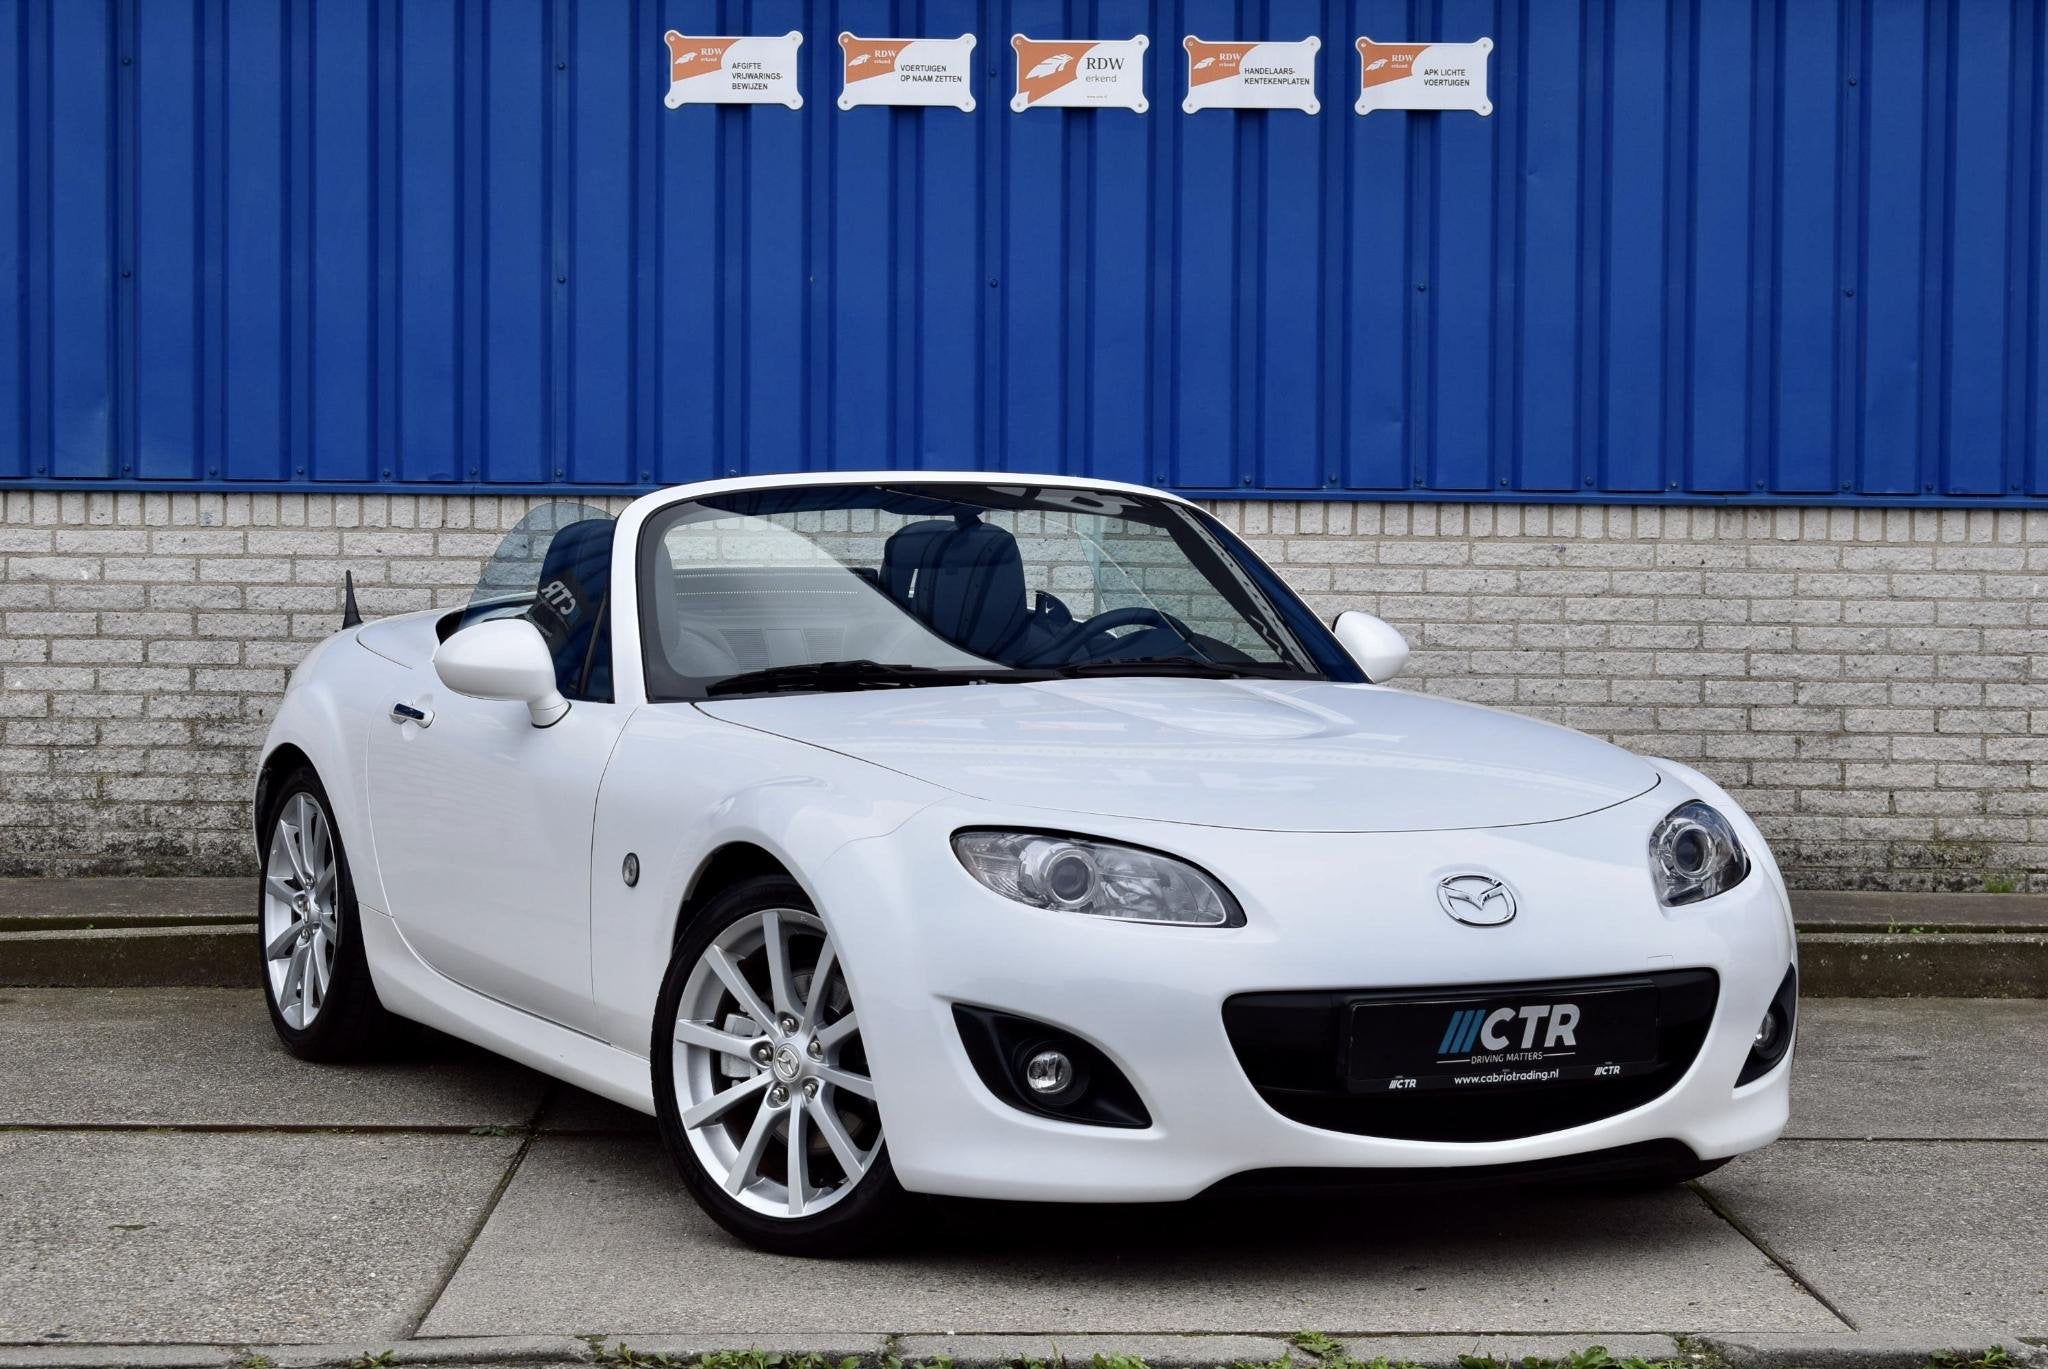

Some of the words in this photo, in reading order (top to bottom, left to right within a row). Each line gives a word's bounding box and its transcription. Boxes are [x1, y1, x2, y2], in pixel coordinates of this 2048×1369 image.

[701, 48, 723, 56] RDW
[875, 50, 896, 58] RDW
[1219, 53, 1242, 61] RDW
[1391, 54, 1414, 62] RDW
[732, 62, 763, 70] AFGIFTE
[1086, 57, 1126, 70] RDW
[900, 64, 947, 72] VOERTUIGEN
[1244, 67, 1296, 76] HANDELAARS-
[732, 72, 784, 81] VRIJWARINGS-
[913, 75, 934, 83] NAAM
[935, 75, 962, 83] ZETTEN
[1085, 74, 1117, 83] erkend
[1244, 77, 1310, 85] KENTEKENPLATEN
[1424, 79, 1470, 87] VOERTUIGEN
[1480, 1003, 1581, 1051] CTR
[1471, 1053, 1504, 1064] DRIVING
[1506, 1051, 1543, 1062] MATTERS
[1601, 1065, 1620, 1075] CTR
[1454, 1069, 1559, 1085] www.cabriotrading.nl
[1396, 1079, 1416, 1088] CTR
